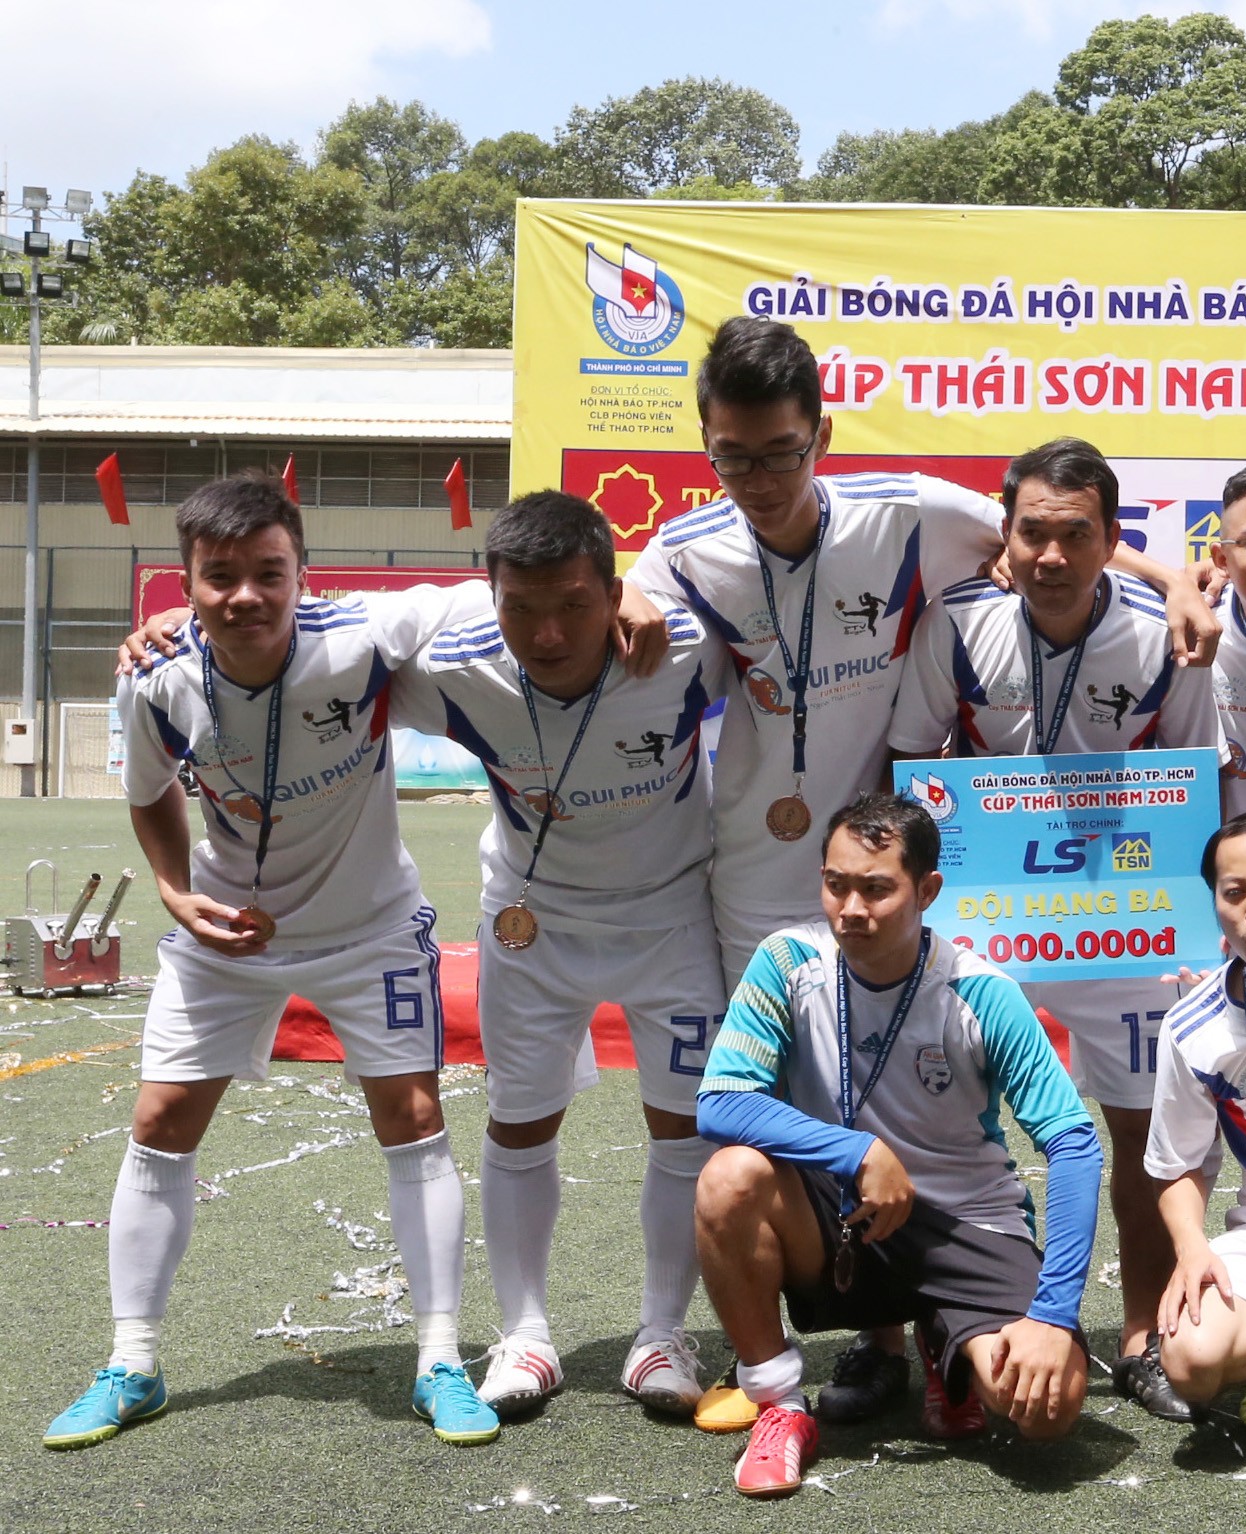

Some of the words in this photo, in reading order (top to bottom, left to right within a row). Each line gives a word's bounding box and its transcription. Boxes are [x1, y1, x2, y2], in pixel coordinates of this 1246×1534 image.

[748, 278, 827, 317] GIẢI
[841, 282, 949, 319] BÓNG
[960, 282, 1014, 319] ĐÁ
[1028, 284, 1094, 327] HỘI
[1108, 285, 1189, 321] NHÀ
[662, 365, 683, 374] MINH
[817, 353, 884, 403] ÚP
[902, 355, 1026, 409] THÁI
[1045, 361, 1145, 407] SƠN
[590, 411, 610, 420] CLB
[609, 424, 635, 433] THAO
[809, 665, 830, 689] UI
[834, 651, 890, 683] PHUC
[272, 775, 320, 802] QUI
[320, 737, 375, 785] PHUC
[569, 787, 616, 807] QUI
[621, 768, 679, 799] PHUC
[972, 775, 999, 788] GIẢI
[1002, 775, 1037, 787] BÓNG
[1040, 773, 1058, 785] ĐÁ
[1060, 772, 1082, 786] HỘI
[1086, 771, 1112, 784] NHÀ
[1116, 770, 1141, 783] BÁO
[1167, 769, 1195, 781] HCM
[983, 793, 1016, 811] CÚP
[1021, 790, 1062, 811] THÁI
[1067, 791, 1101, 808] SƠN
[1105, 791, 1143, 808] NAM
[1150, 789, 1186, 804] 2018
[1023, 838, 1087, 875] LS
[1114, 855, 1150, 869] TSN
[957, 890, 1013, 925] ĐỘI
[1024, 890, 1118, 923] HẠNG
[1128, 887, 1173, 913] BA
[383, 967, 424, 1030] 6
